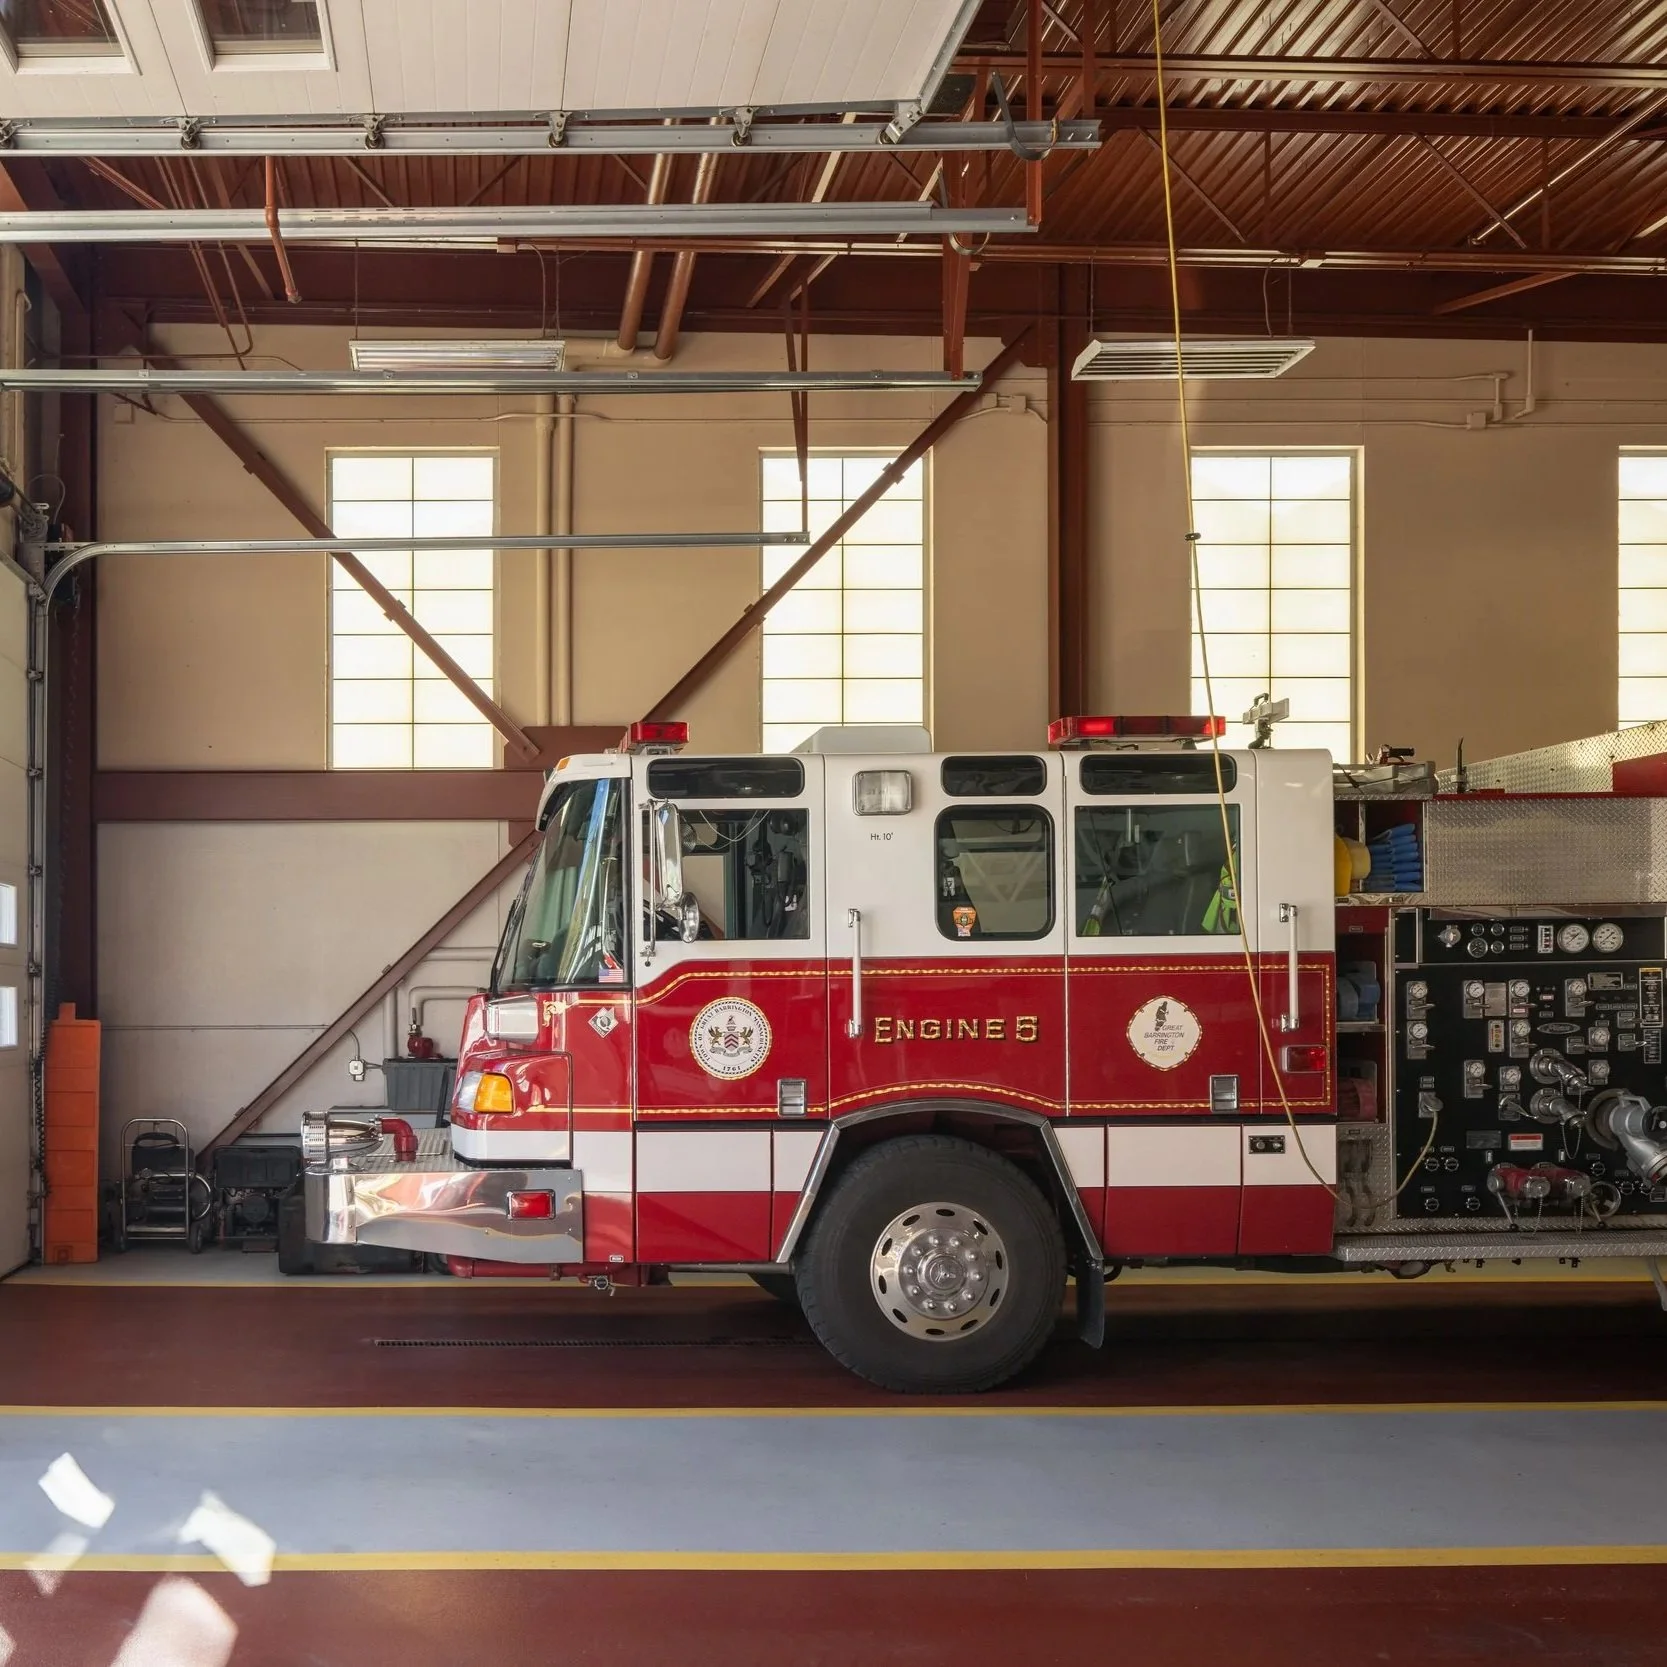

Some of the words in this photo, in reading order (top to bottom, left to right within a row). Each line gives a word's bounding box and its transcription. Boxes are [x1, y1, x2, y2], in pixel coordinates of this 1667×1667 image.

[700, 1011, 714, 1029] GREAT
[714, 1005, 752, 1017] BARRINGTON
[874, 1016, 1006, 1043] ENGINE
[1015, 1015, 1039, 1042] 5
